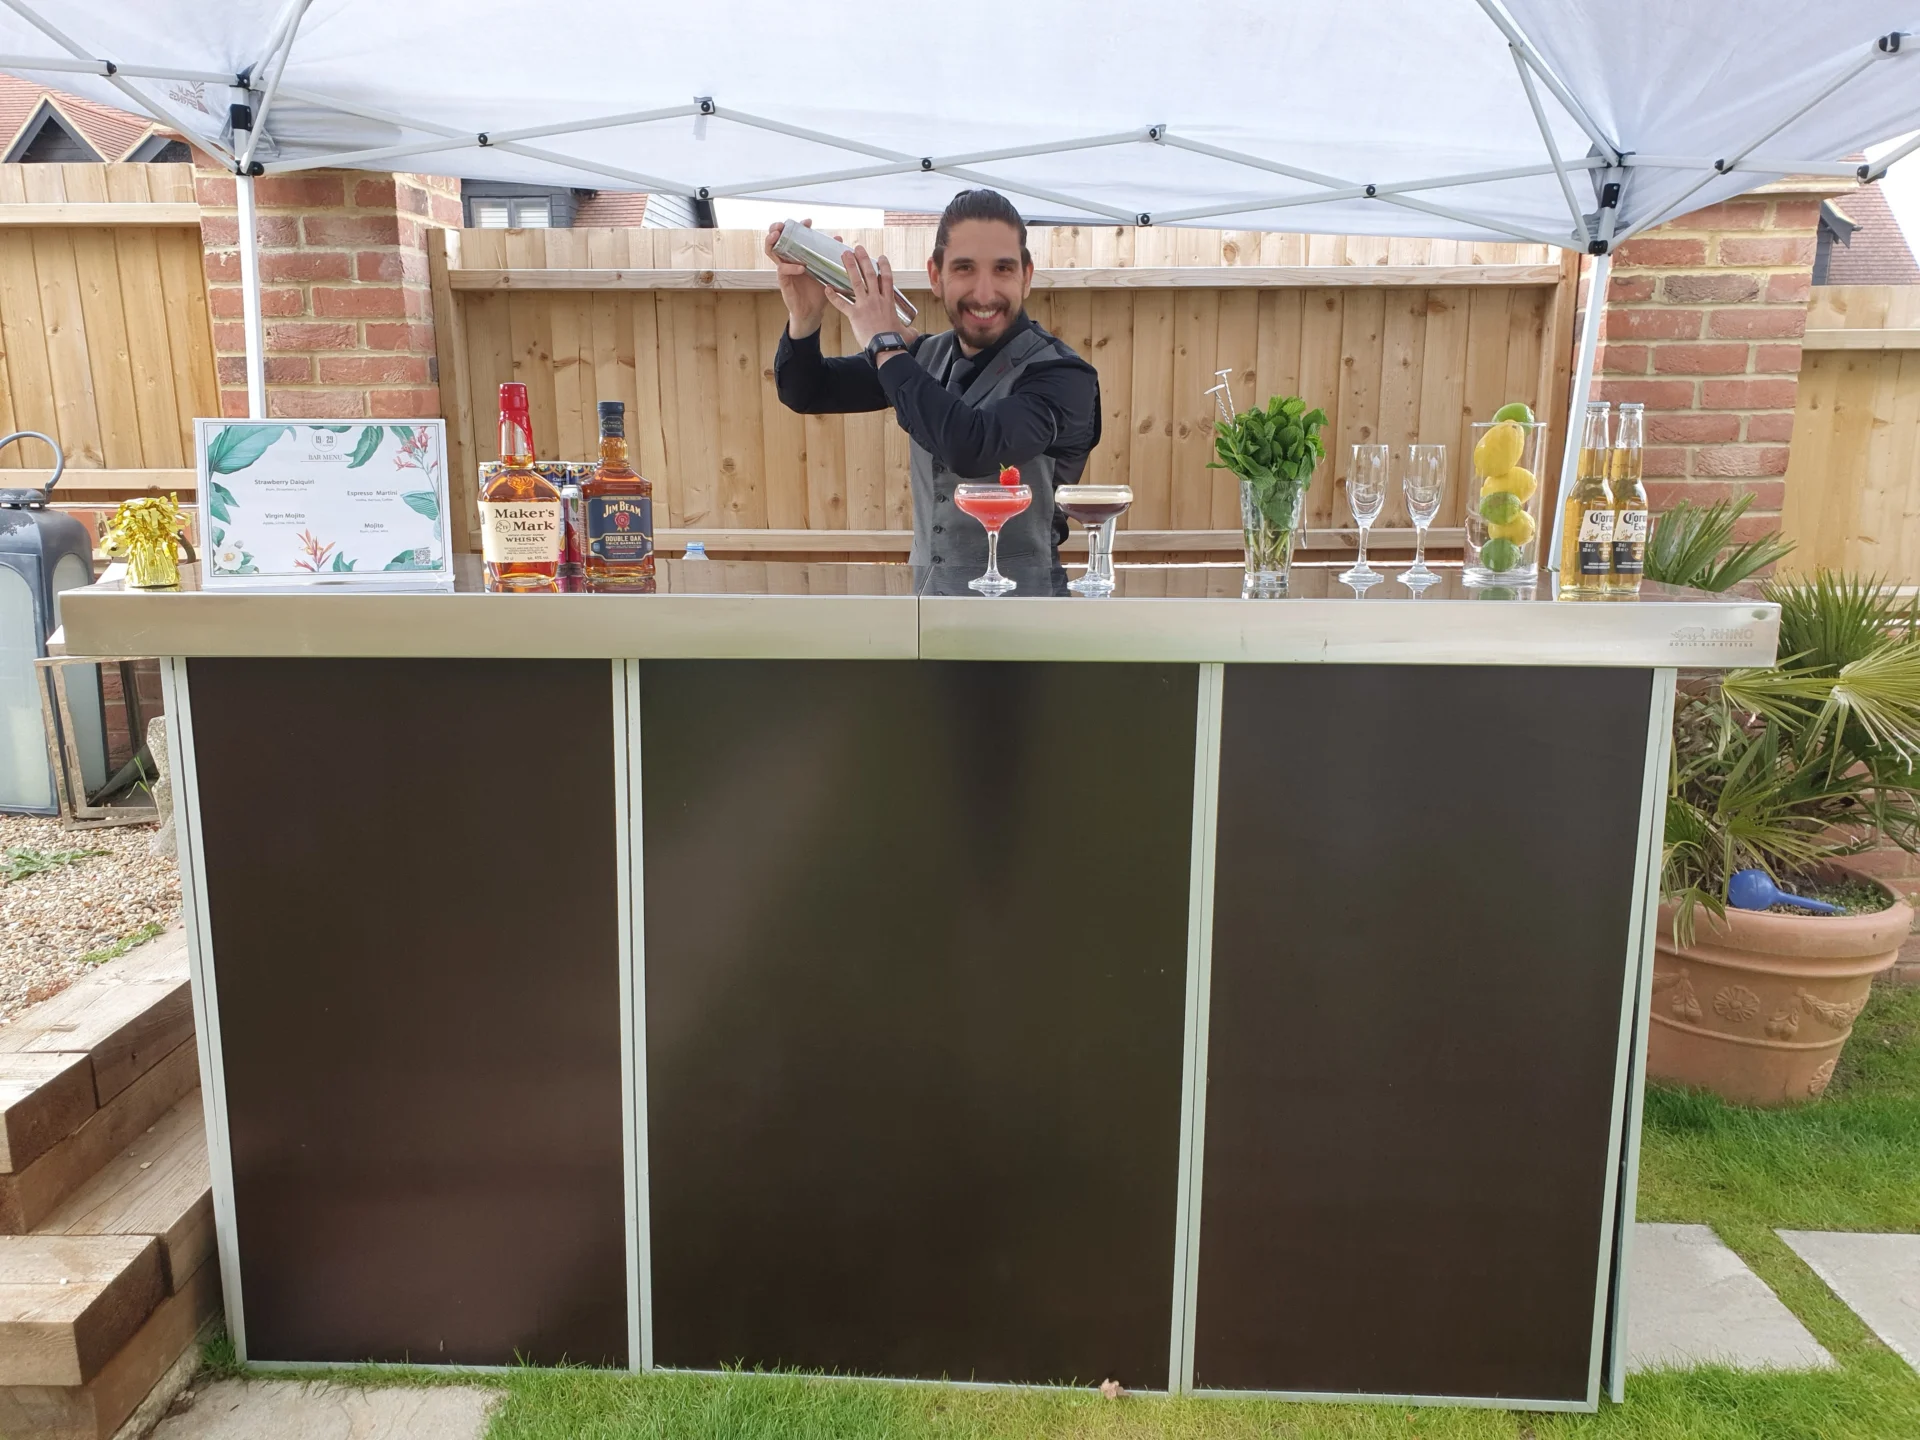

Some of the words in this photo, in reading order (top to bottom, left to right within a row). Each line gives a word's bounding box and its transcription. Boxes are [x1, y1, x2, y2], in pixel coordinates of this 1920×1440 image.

[326, 435, 334, 444] 29
[289, 478, 315, 486] Daiquiri
[494, 508, 555, 519] Maker's
[602, 503, 619, 518] JIM
[619, 500, 642, 517] BEAM
[264, 512, 284, 520] Virgin
[285, 512, 306, 520] Mojito
[364, 522, 384, 530] Mojito
[512, 520, 555, 532] Mark
[1710, 628, 1755, 640] RHINO
